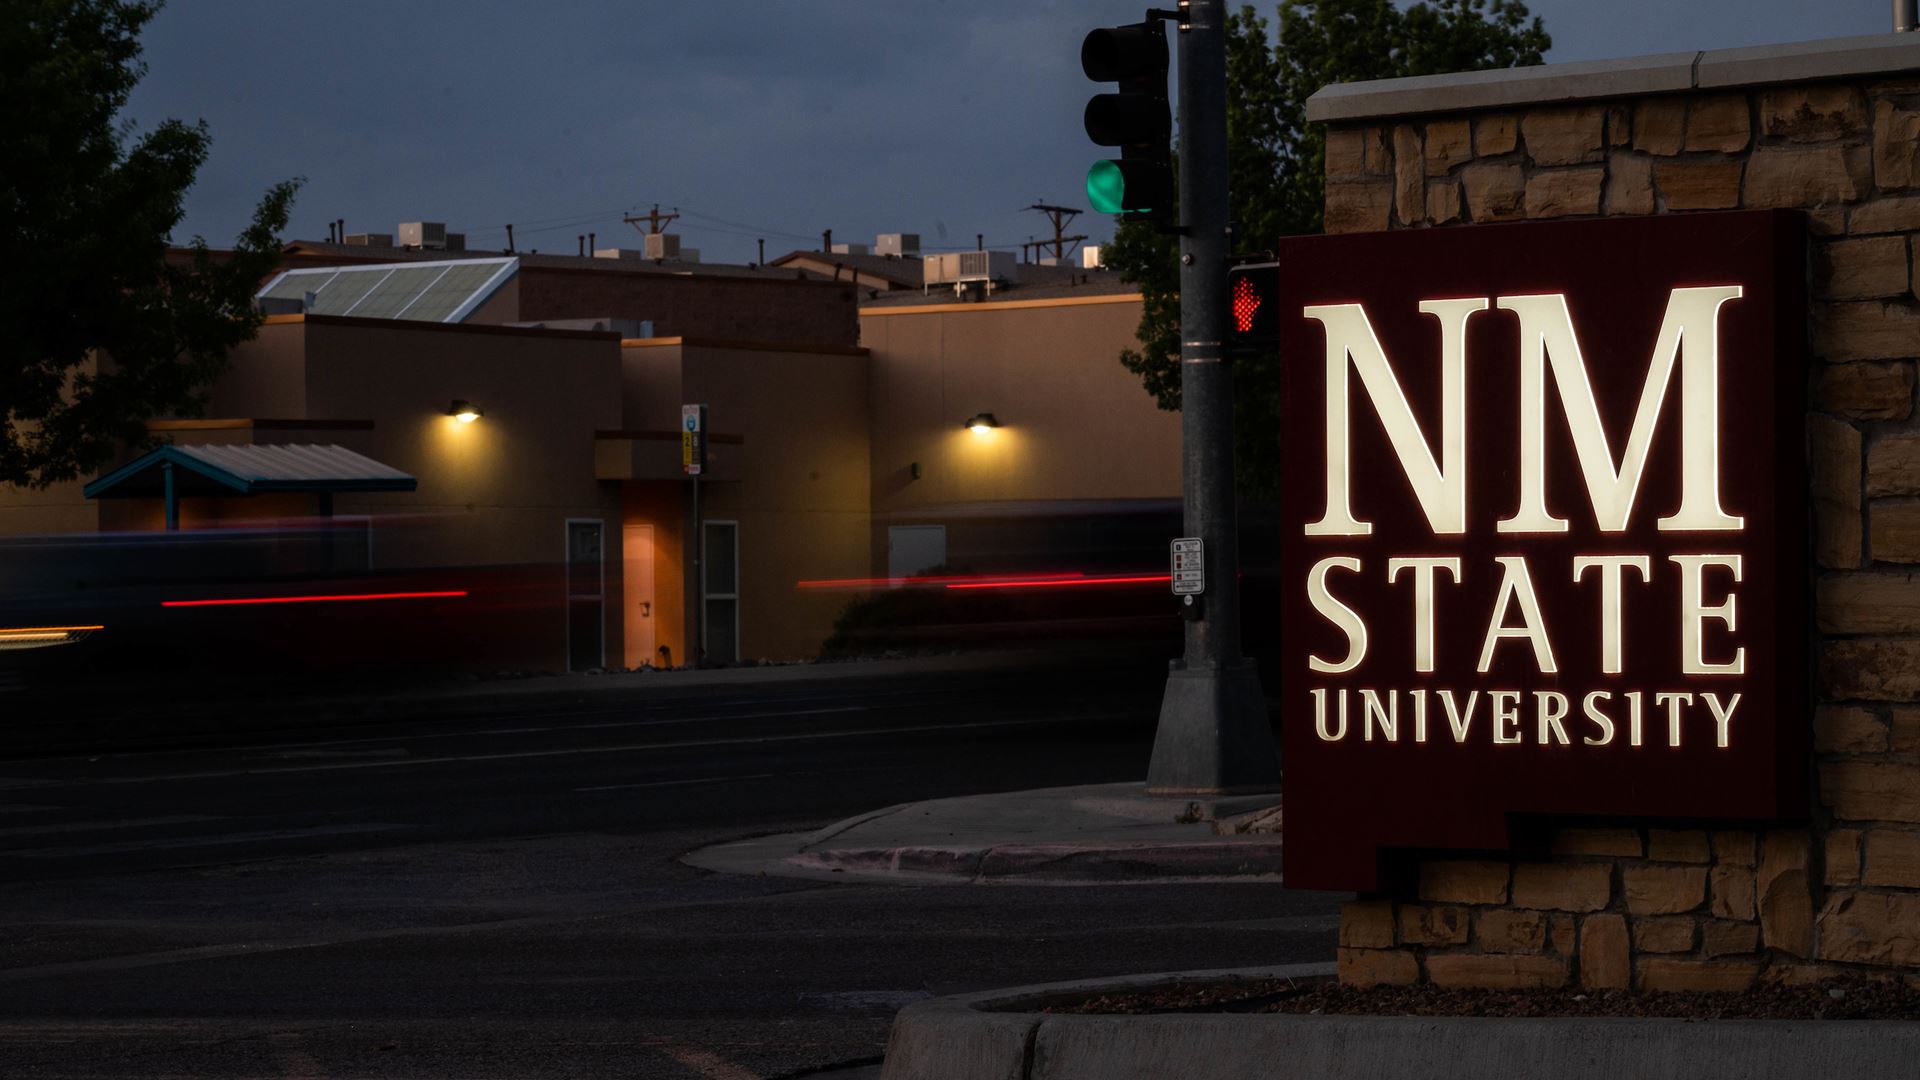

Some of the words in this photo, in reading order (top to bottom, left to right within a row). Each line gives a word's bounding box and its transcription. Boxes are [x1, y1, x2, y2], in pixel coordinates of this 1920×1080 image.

[1304, 286, 1745, 536] NM
[1307, 554, 1745, 675] STATE
[1311, 689, 1742, 747] UNIVERSITY
